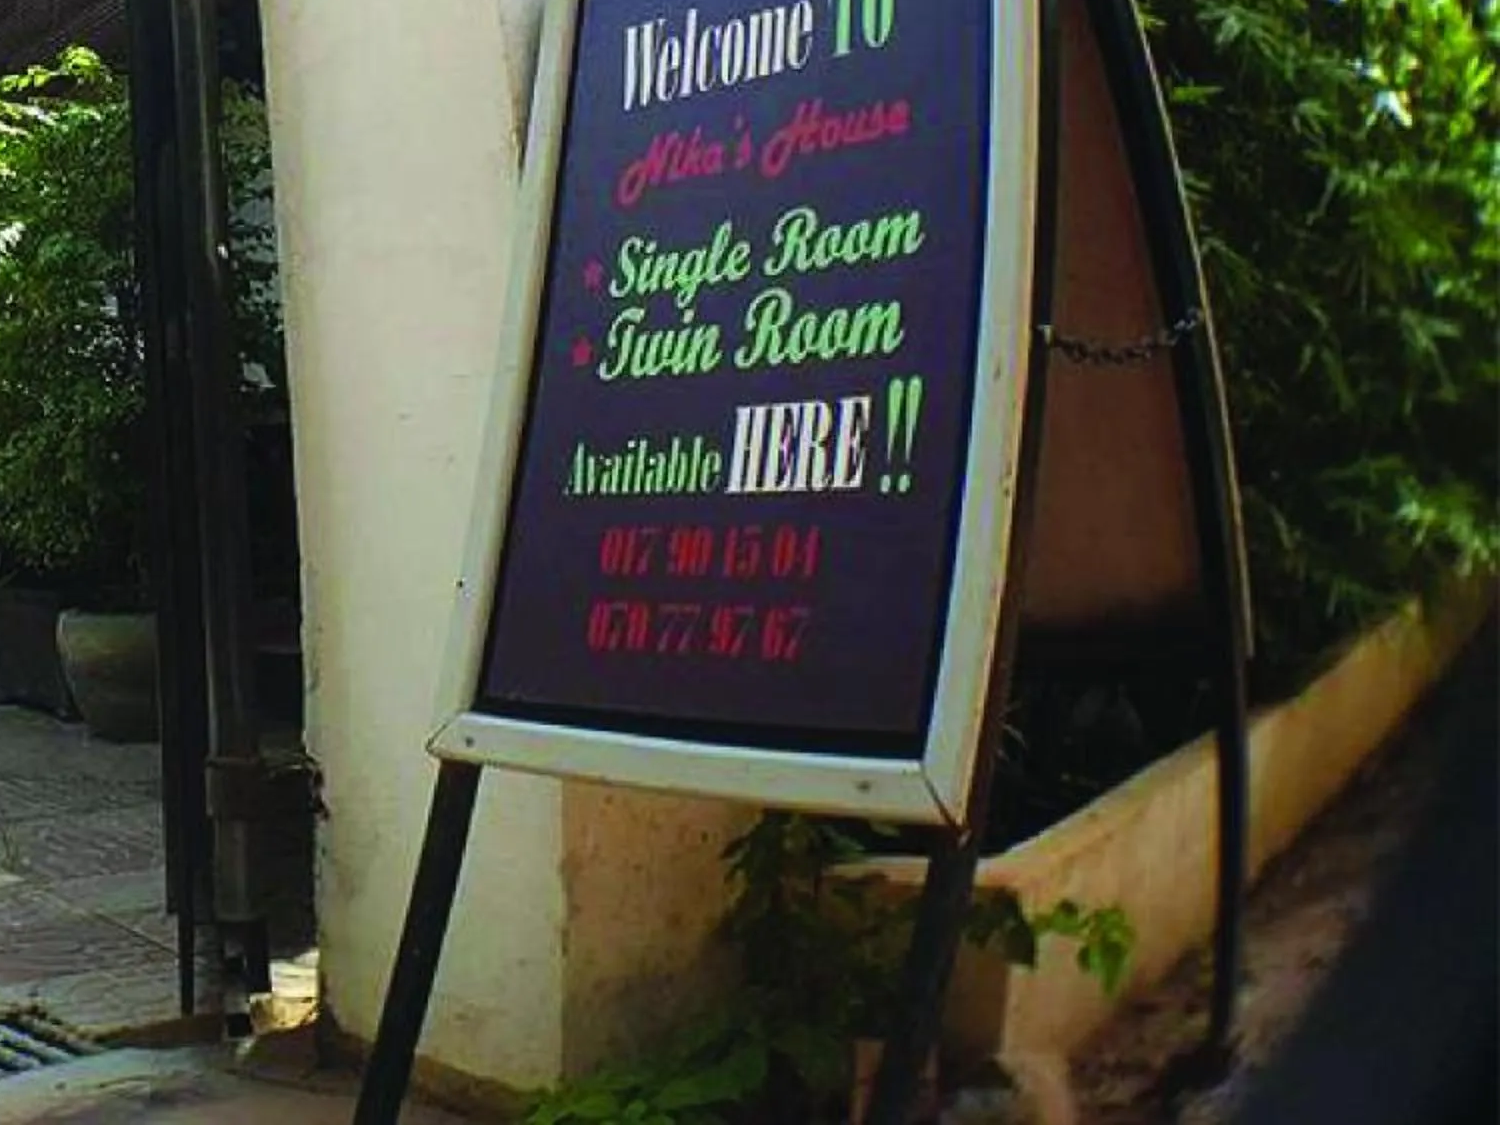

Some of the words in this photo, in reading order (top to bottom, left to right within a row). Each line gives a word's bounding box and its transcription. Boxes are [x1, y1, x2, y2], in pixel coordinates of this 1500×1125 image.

[616, 114, 753, 206] Nika's
[761, 97, 911, 177] House
[609, 219, 752, 309] Single
[764, 207, 926, 277] Room
[598, 306, 723, 382] Twin
[733, 286, 905, 370] Room
[563, 435, 723, 496] Available
[724, 395, 873, 494] HERE
